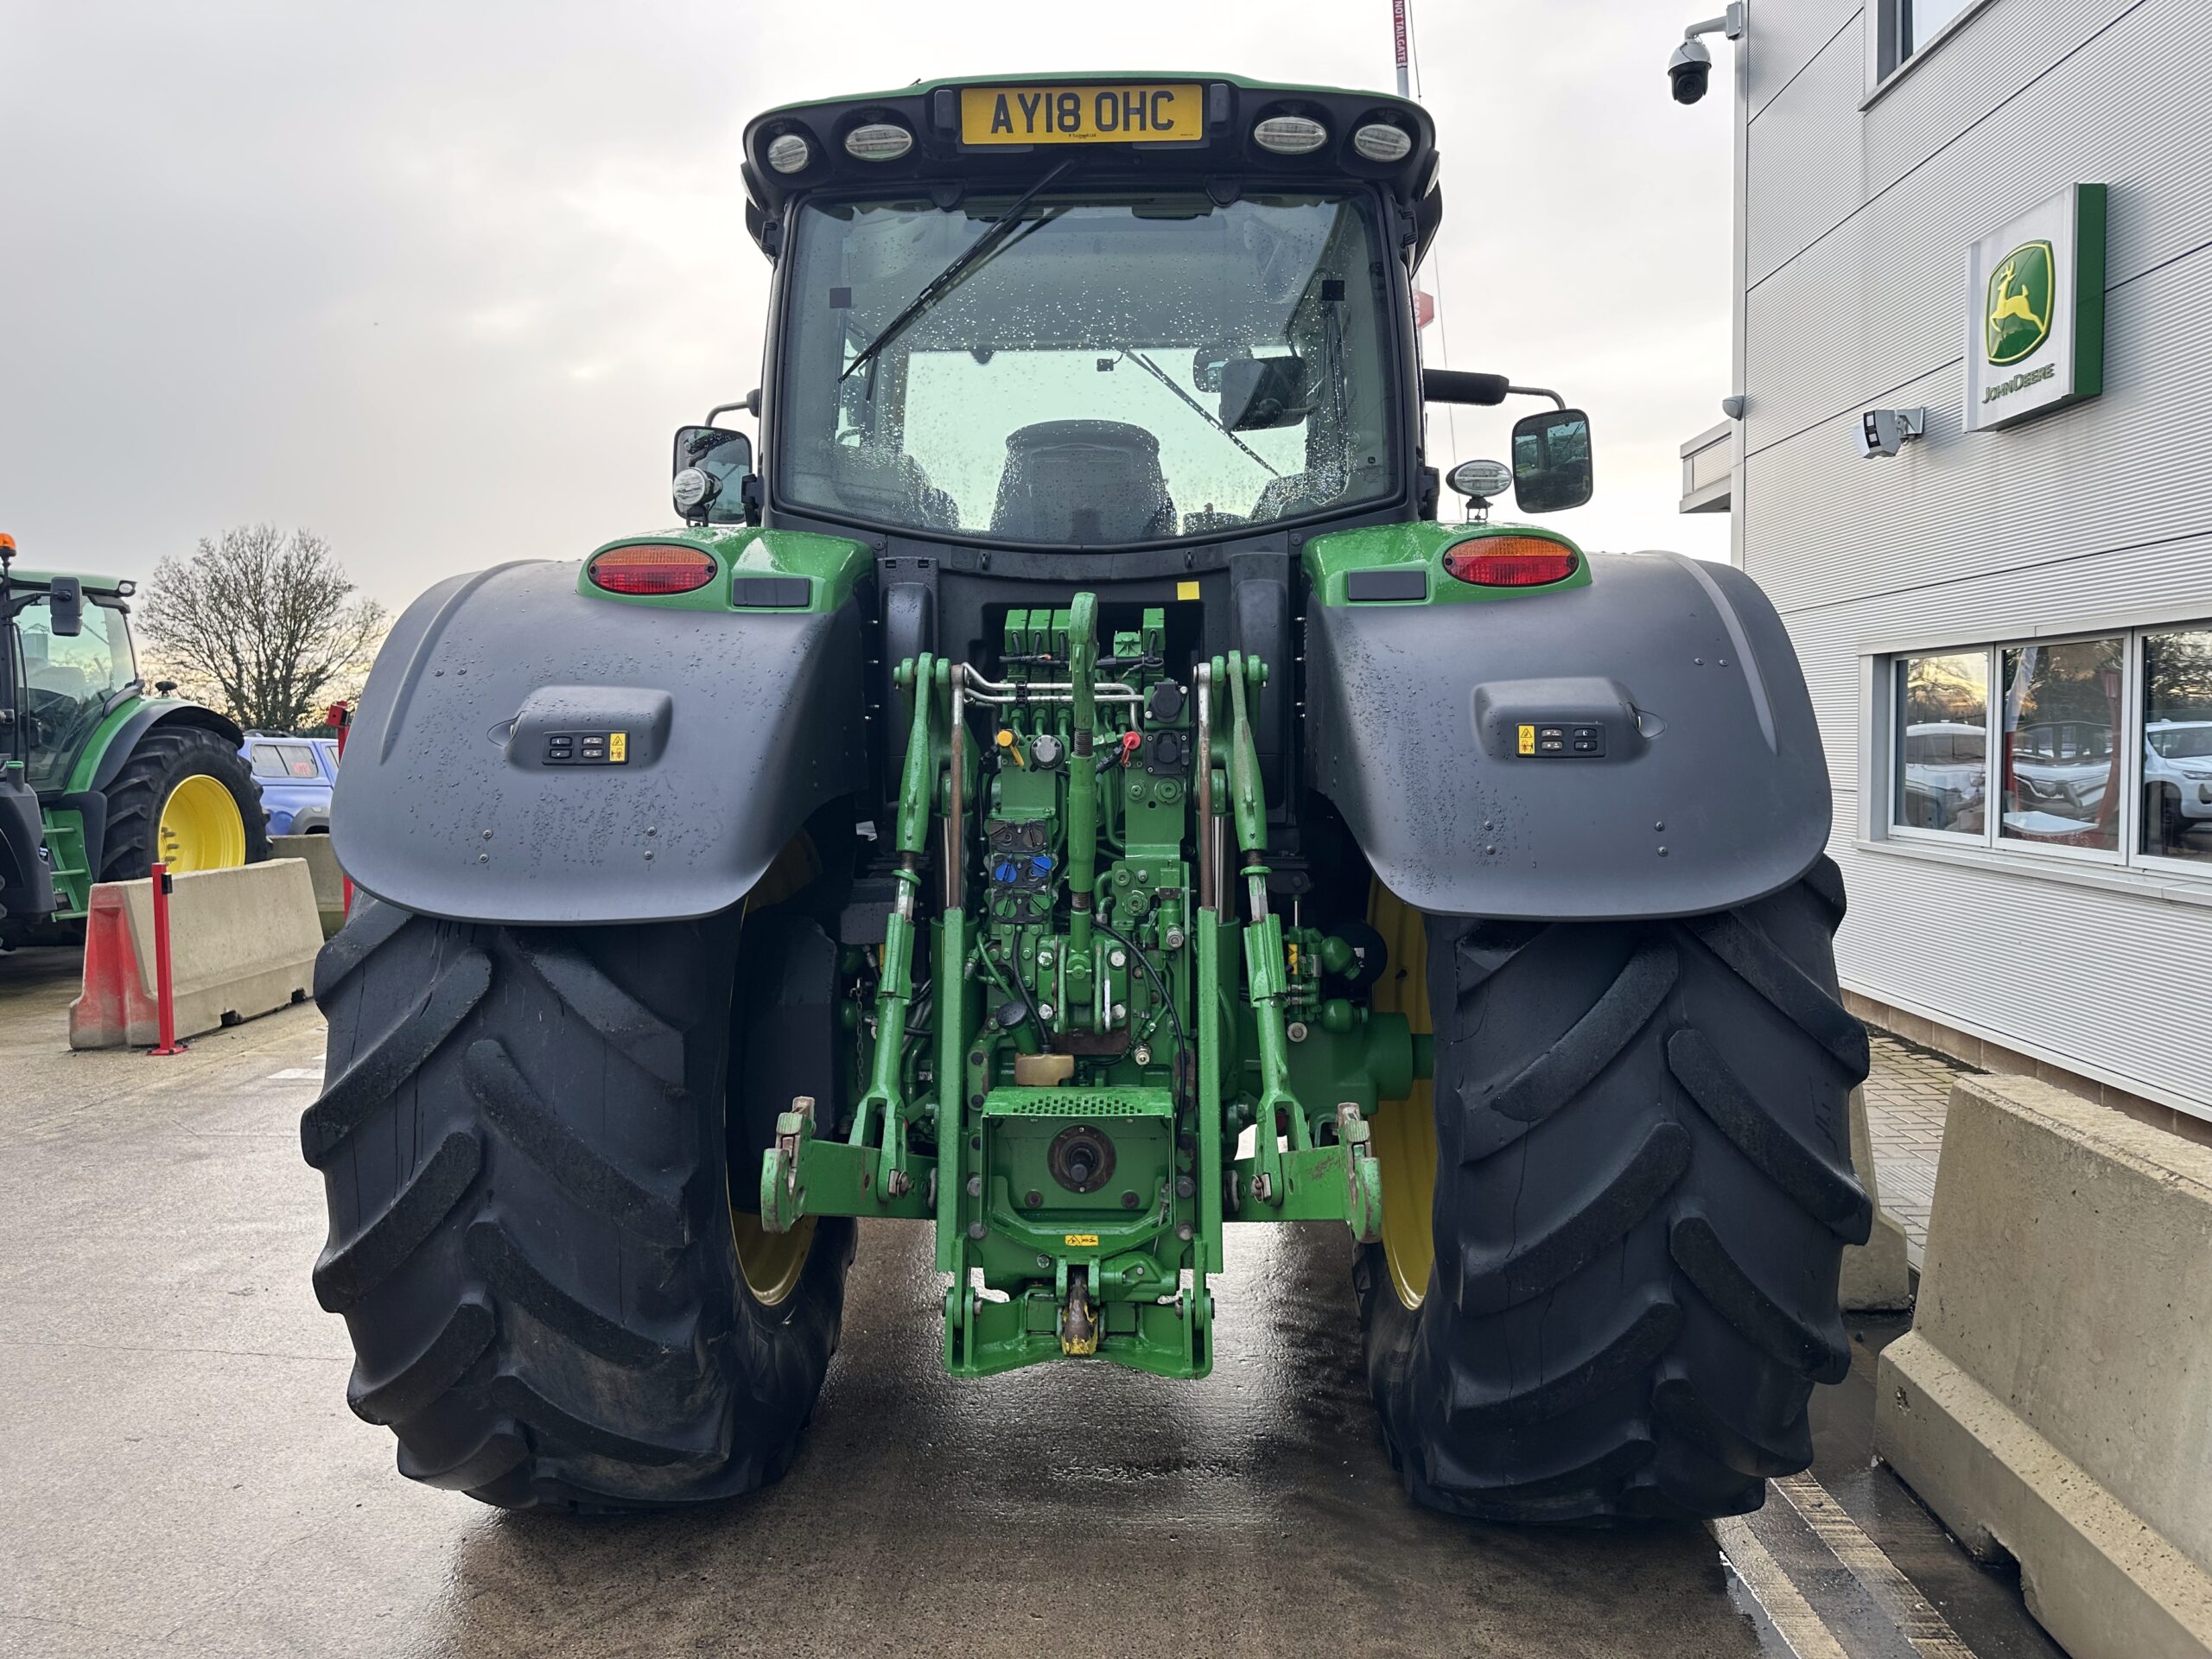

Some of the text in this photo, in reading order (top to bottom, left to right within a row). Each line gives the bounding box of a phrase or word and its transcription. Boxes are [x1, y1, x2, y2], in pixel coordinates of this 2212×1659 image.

[1395, 20, 1406, 62] TAILGATE
[990, 91, 1175, 133] AY18 OHC
